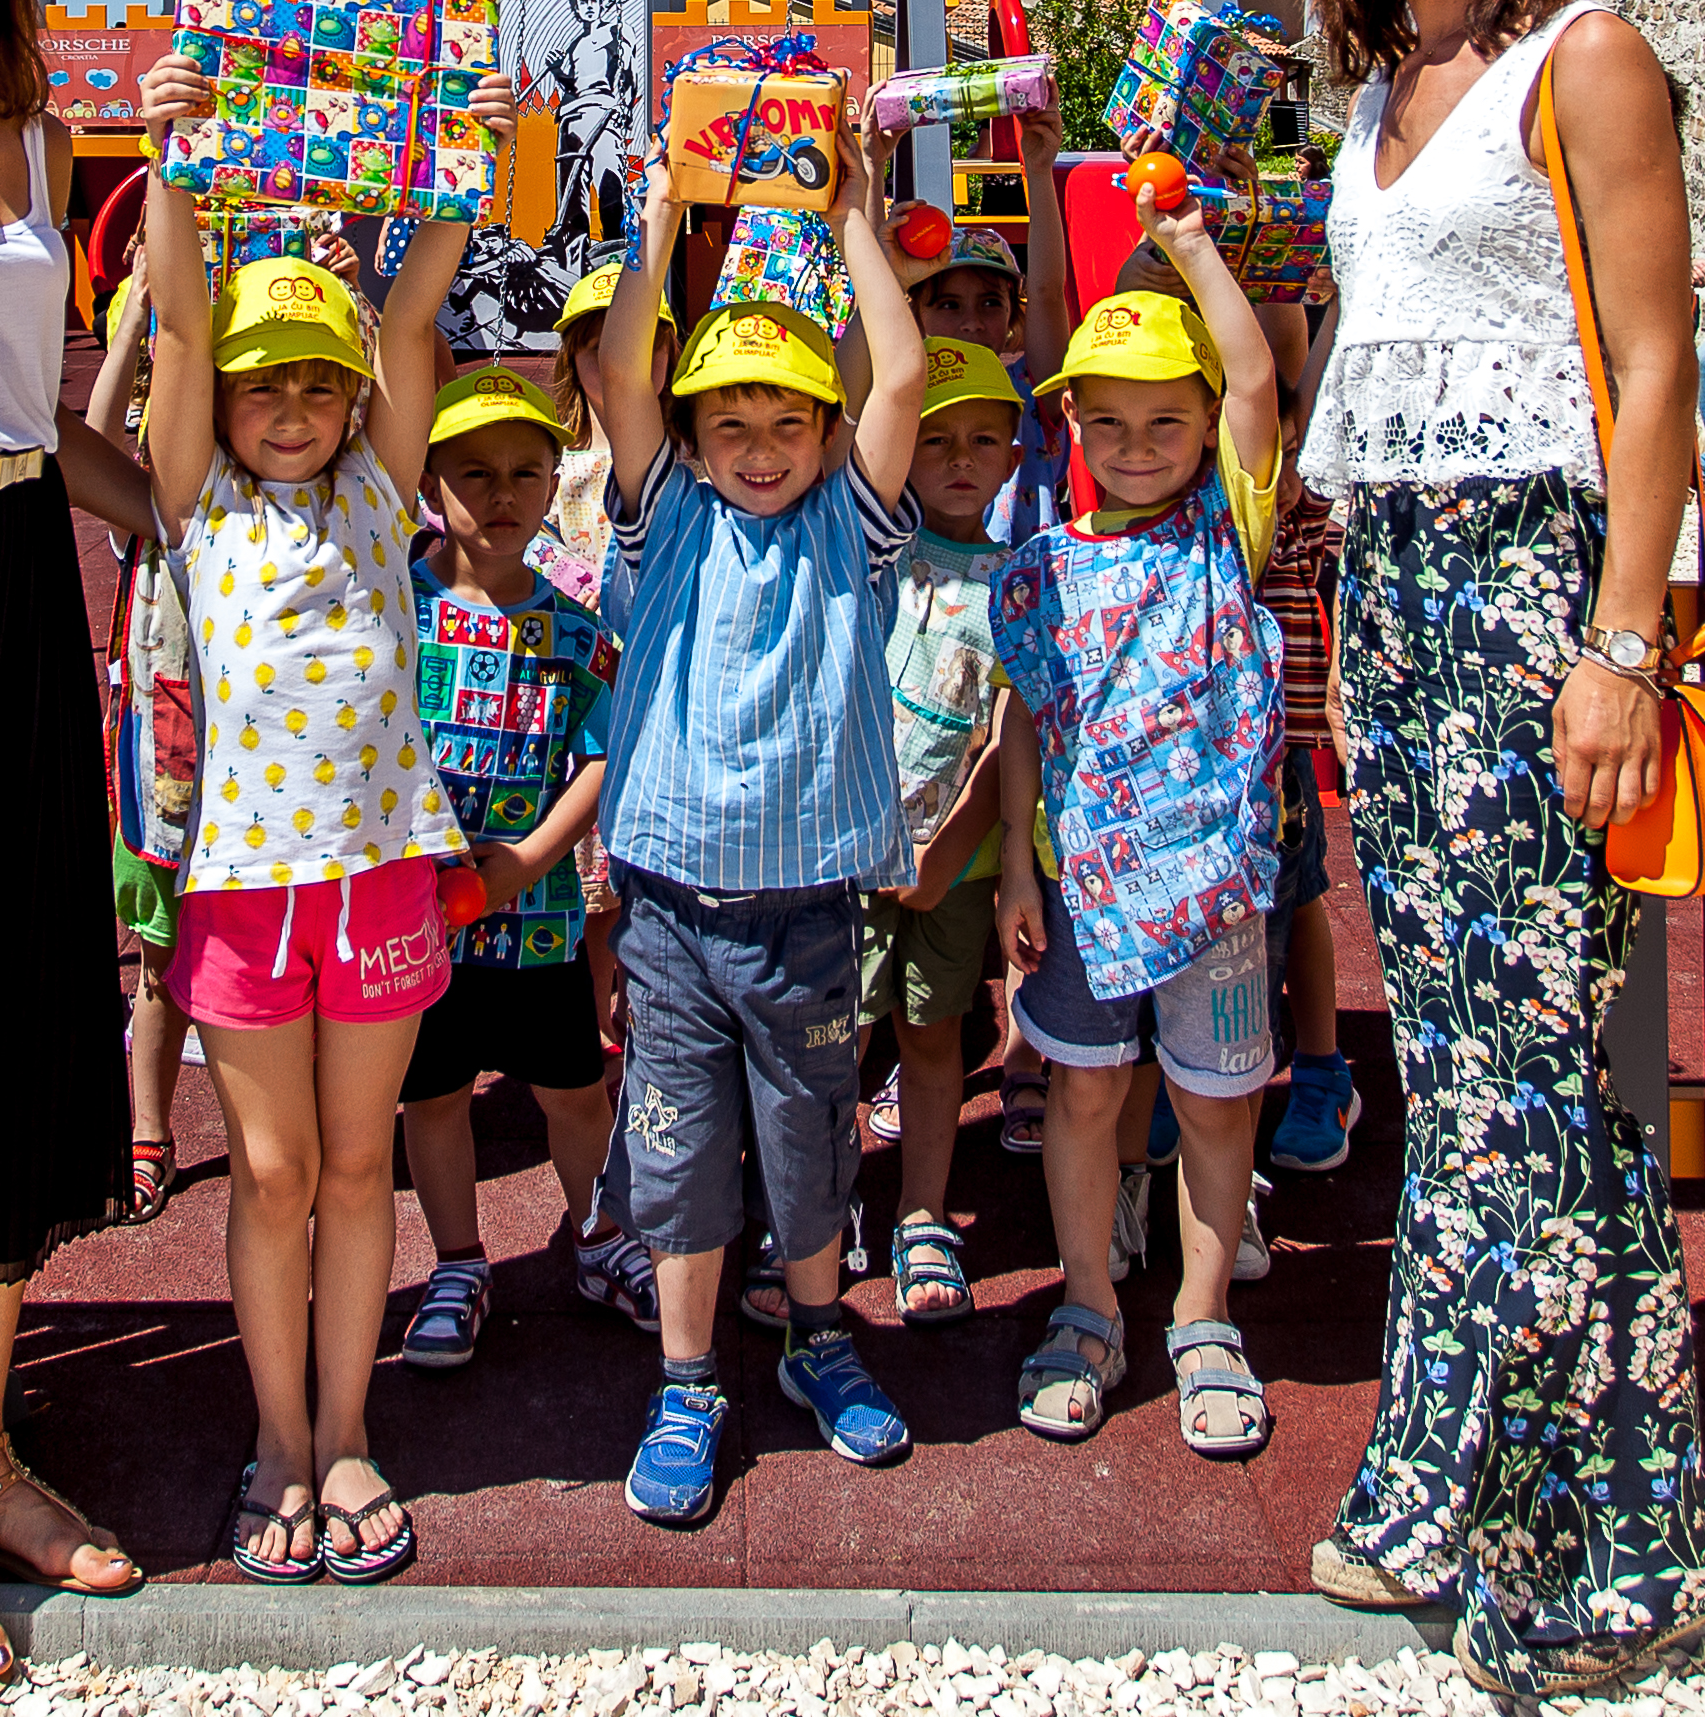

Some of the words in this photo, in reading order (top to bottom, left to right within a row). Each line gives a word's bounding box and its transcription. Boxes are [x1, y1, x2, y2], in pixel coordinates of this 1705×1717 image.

[38, 39, 131, 51] ORSCHE
[362, 980, 391, 999] DON'T
[394, 967, 424, 992] FORGET
